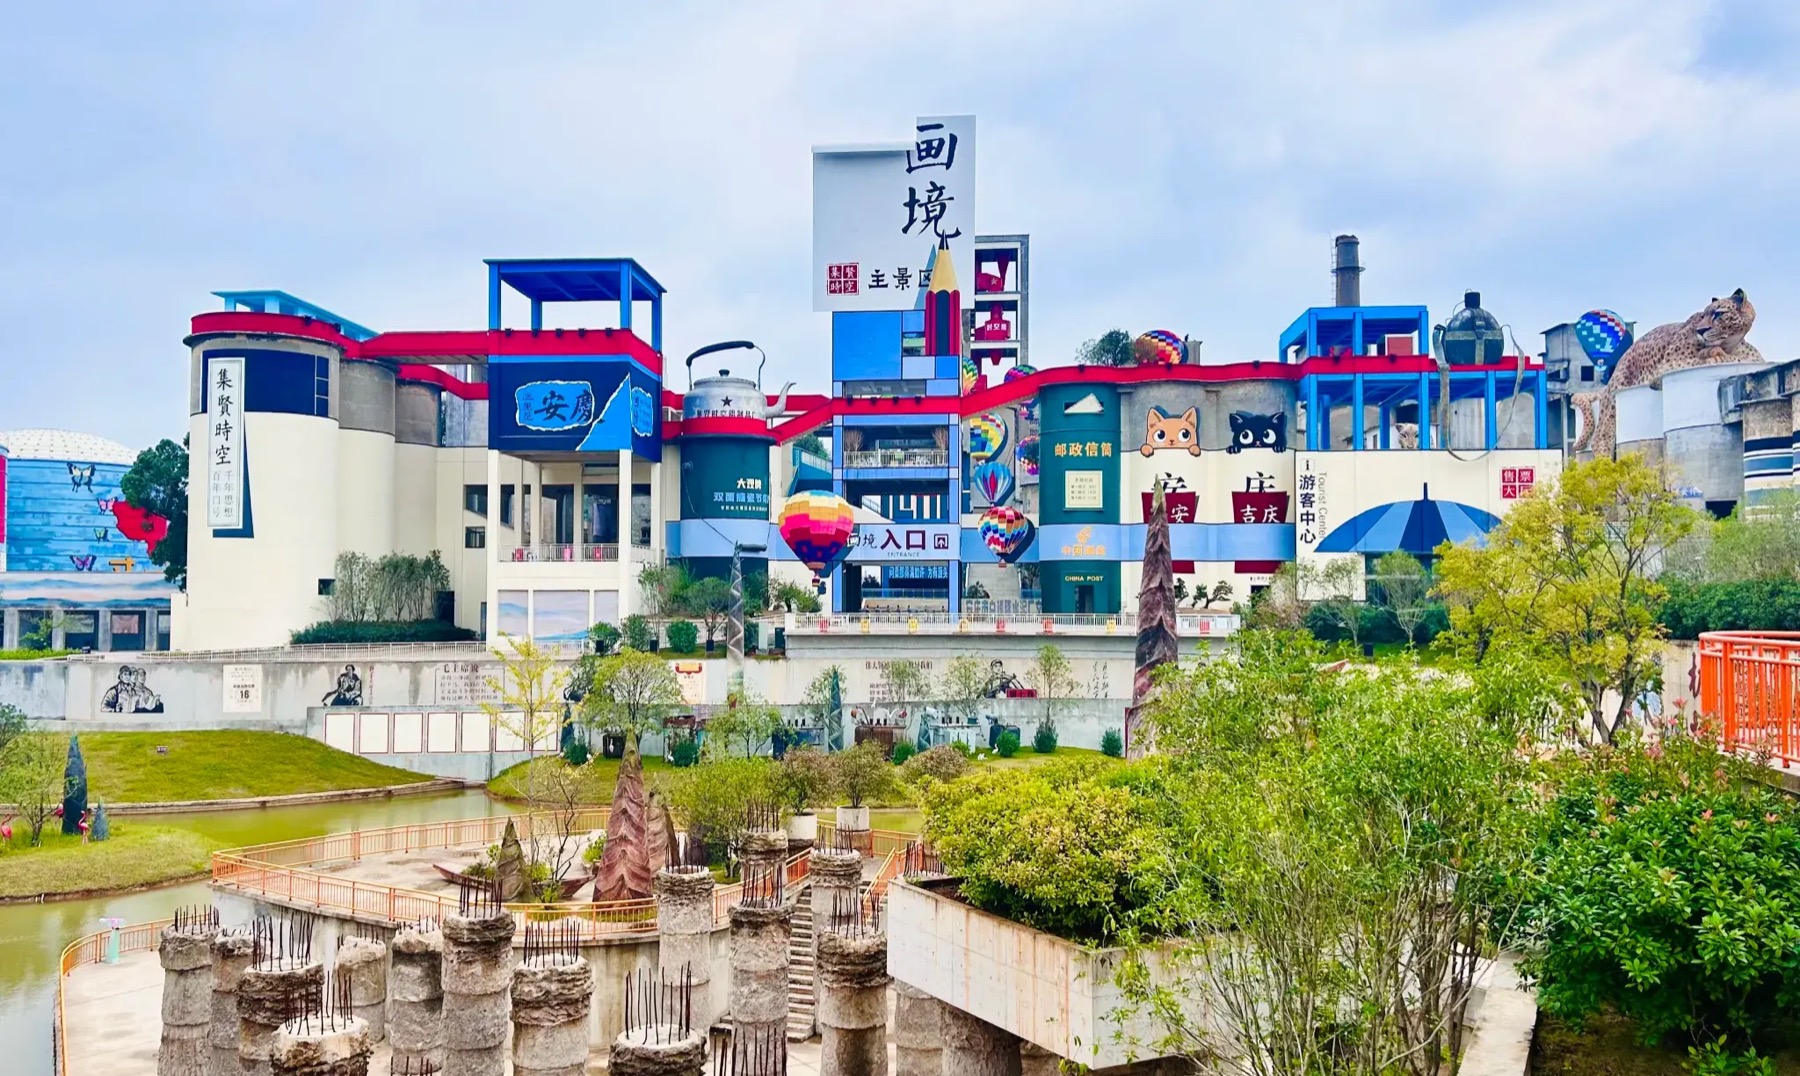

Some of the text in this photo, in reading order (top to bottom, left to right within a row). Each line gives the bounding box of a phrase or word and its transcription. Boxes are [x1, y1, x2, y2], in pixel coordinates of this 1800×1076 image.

[901, 123, 962, 239] 画境
[1054, 441, 1113, 457] 邮政信筒
[1502, 469, 1533, 483] 售票
[224, 470, 234, 519] 千年思想
[1299, 474, 1316, 544] 游客中心
[1318, 472, 1328, 539] Tourist Center
[1240, 504, 1280, 523] 吉庆
[240, 690, 250, 699] 16
